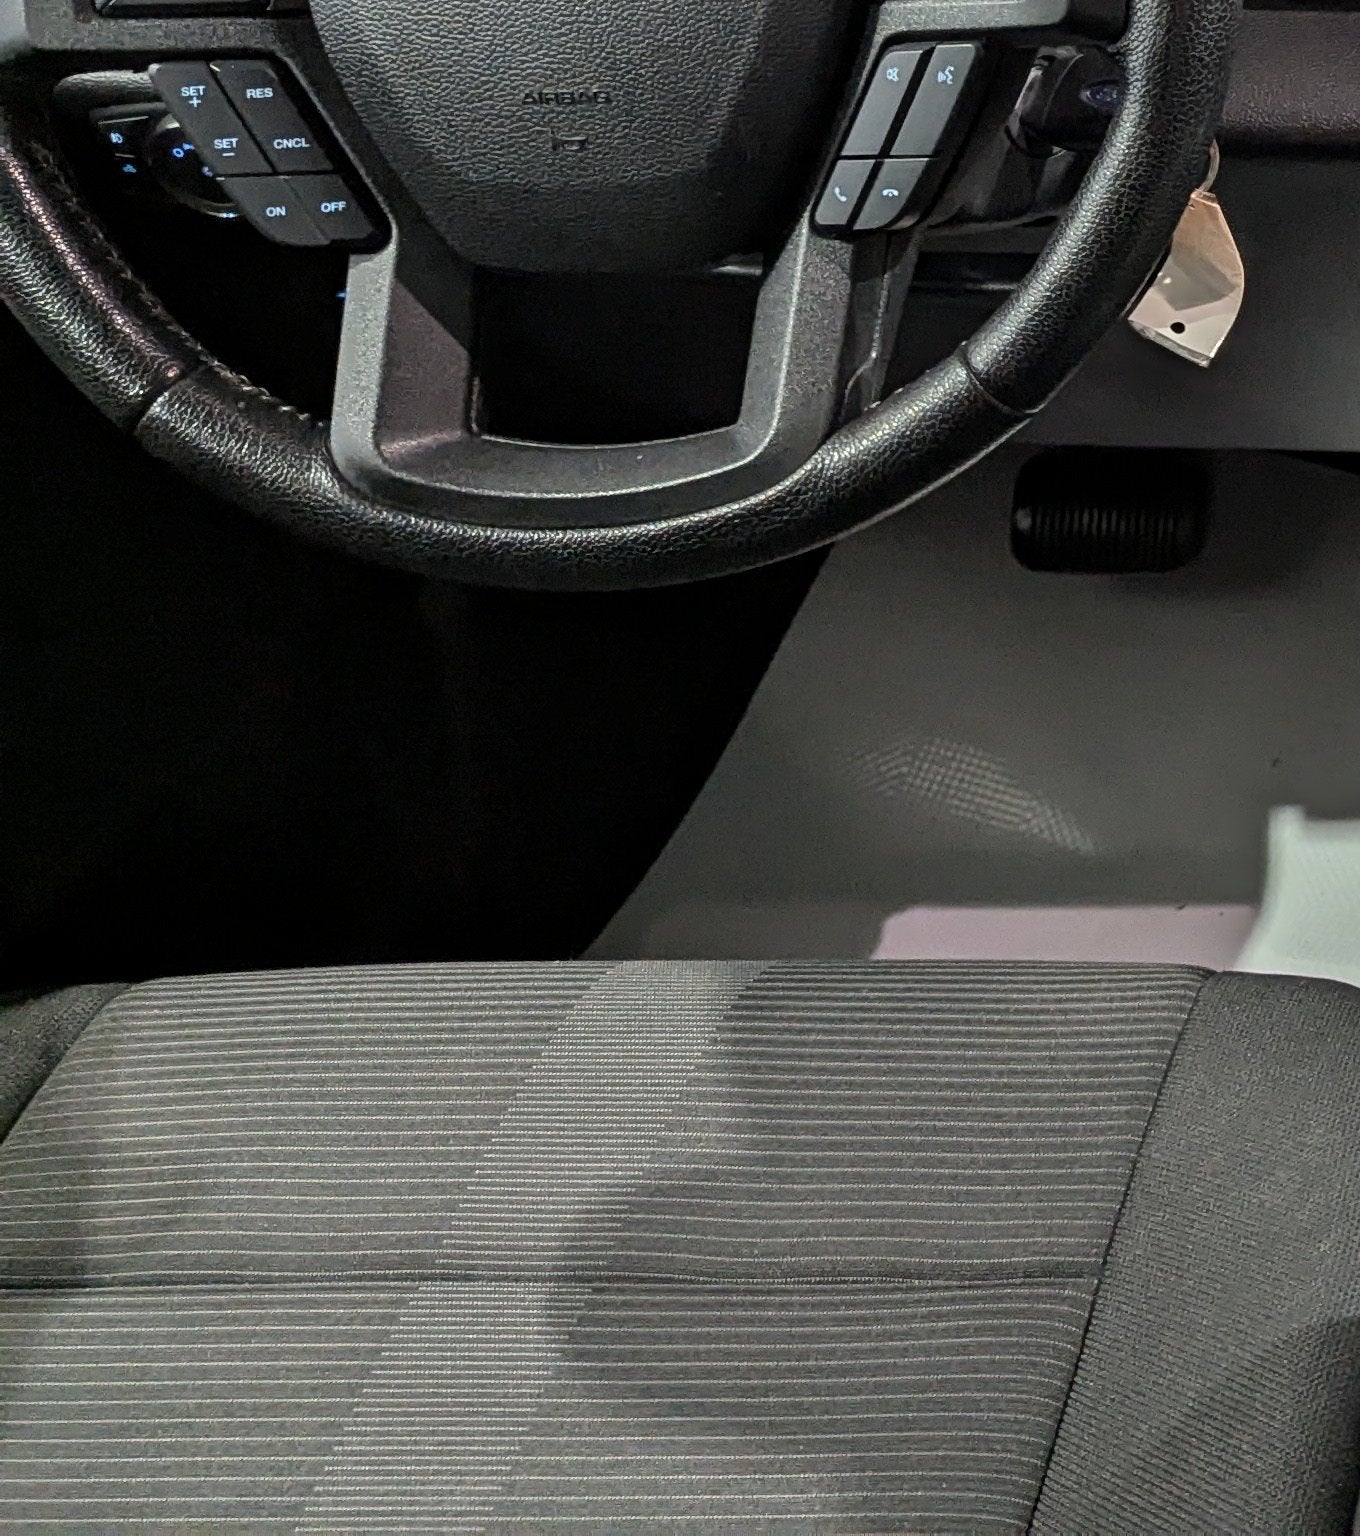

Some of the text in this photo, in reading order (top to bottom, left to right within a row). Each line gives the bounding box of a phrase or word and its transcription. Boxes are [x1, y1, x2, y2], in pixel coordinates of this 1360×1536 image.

[181, 85, 206, 97] SET
[246, 87, 273, 99] RES
[213, 138, 239, 149] SET
[273, 137, 310, 149] CNCL
[266, 206, 286, 218] ON
[320, 201, 347, 213] OFF
